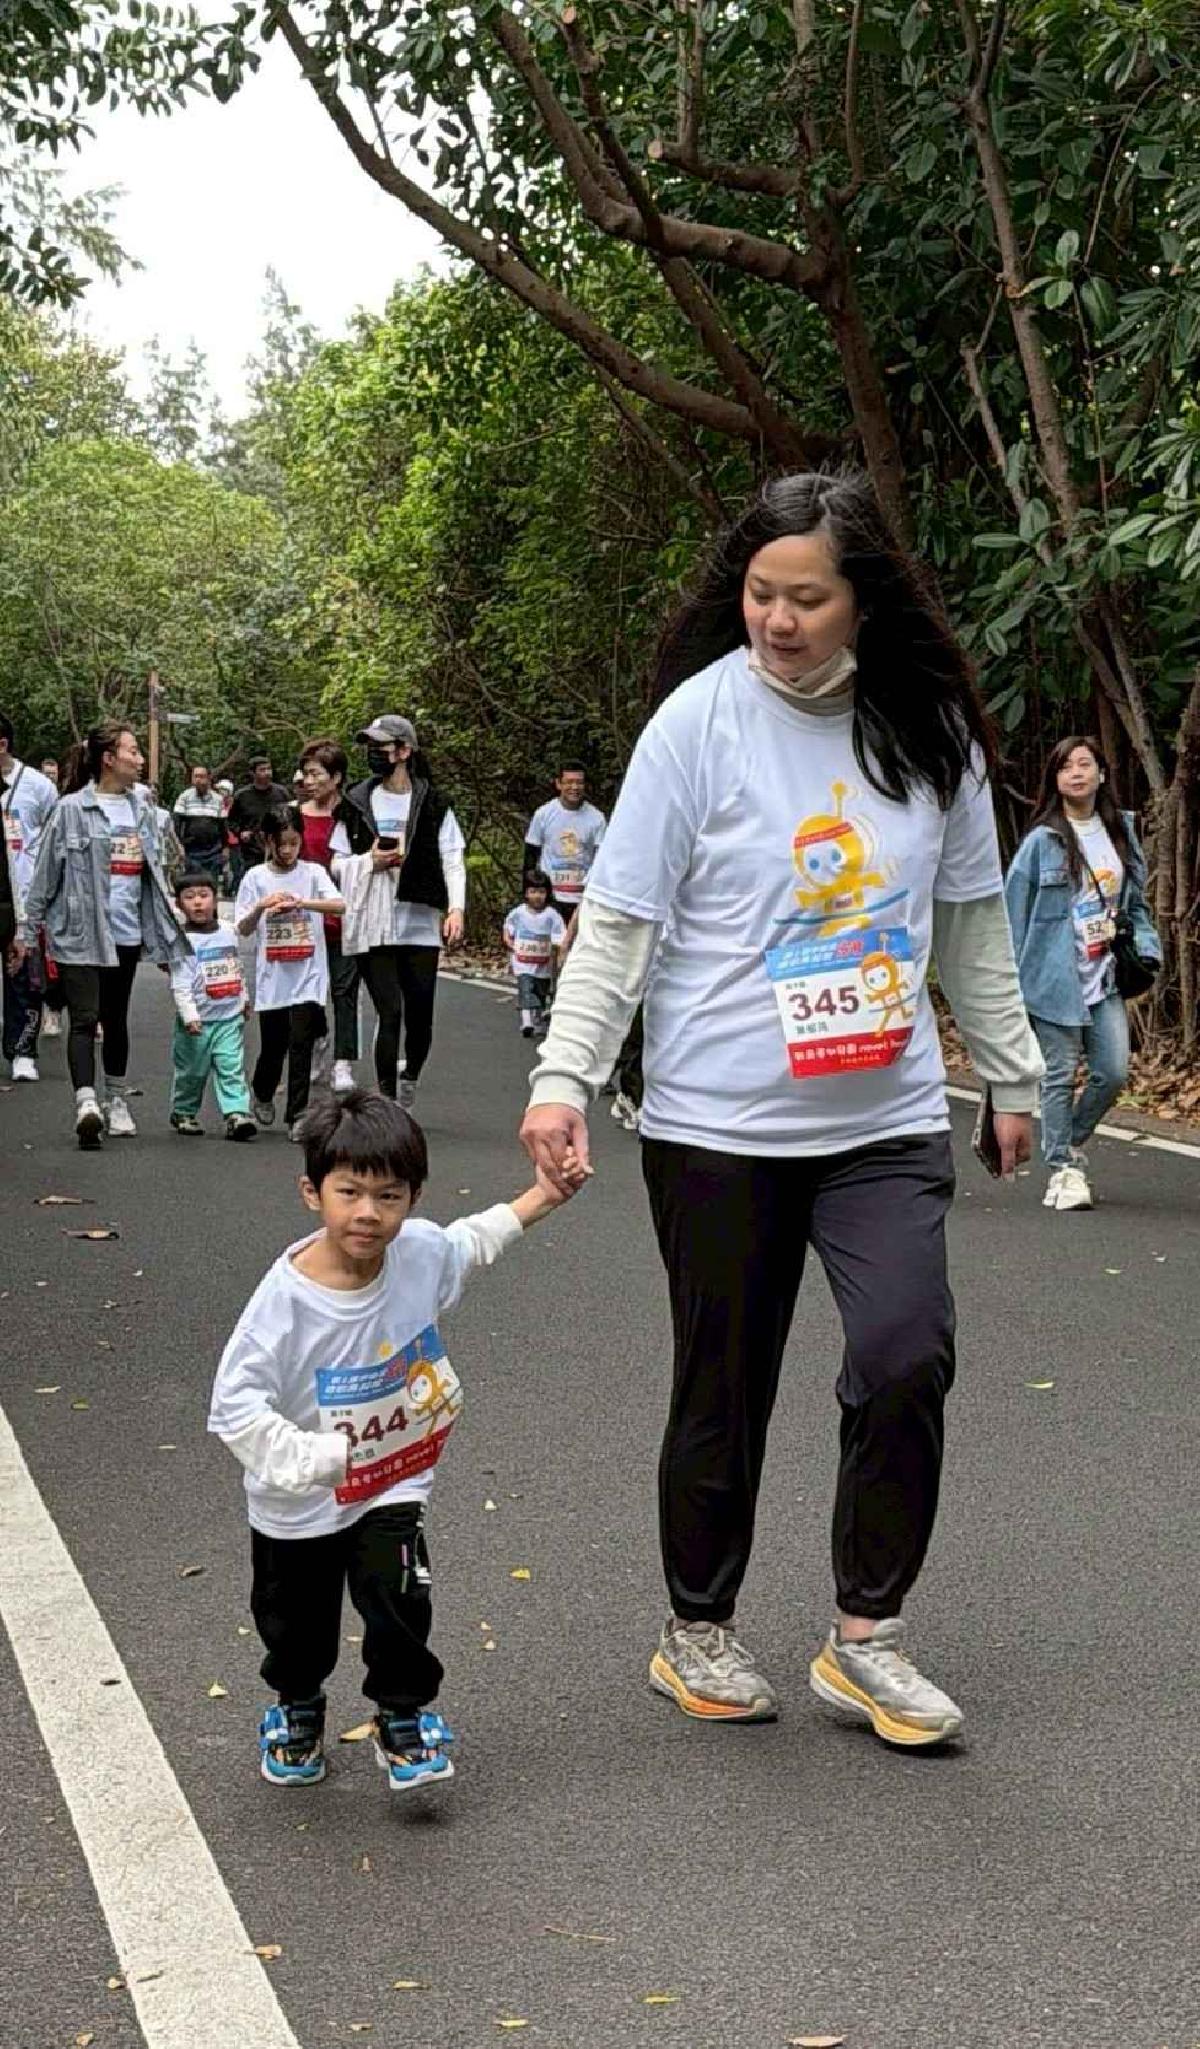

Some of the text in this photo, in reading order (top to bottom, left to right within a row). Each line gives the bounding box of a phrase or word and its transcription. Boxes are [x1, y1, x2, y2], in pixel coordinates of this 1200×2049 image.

[267, 928, 292, 940] 223
[206, 966, 229, 977] 220
[788, 985, 860, 1022] 345
[333, 1405, 409, 1447] 344
